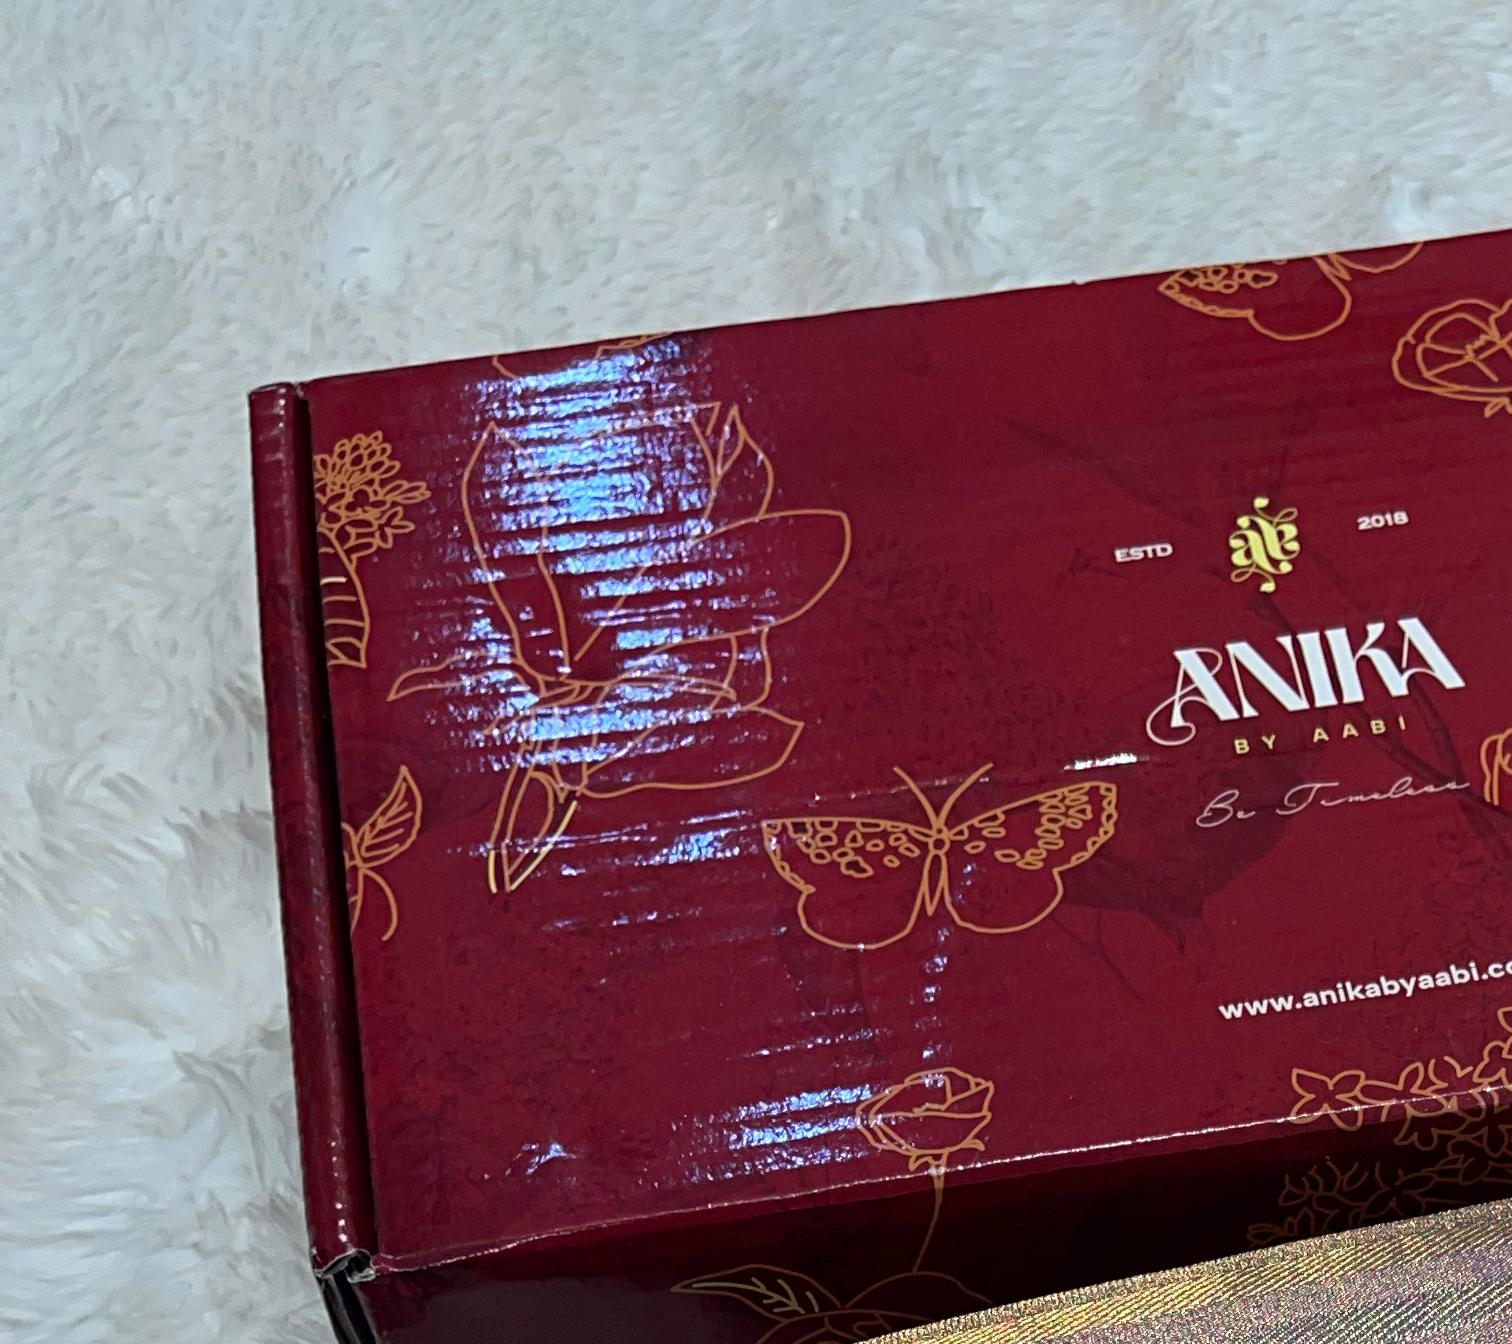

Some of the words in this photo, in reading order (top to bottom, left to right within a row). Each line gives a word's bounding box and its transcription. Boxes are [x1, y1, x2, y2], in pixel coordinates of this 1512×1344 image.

[1356, 510, 1410, 531] 2018
[1113, 542, 1174, 564] ESTD
[1147, 616, 1465, 746] ANIKA
[1233, 733, 1277, 755] BY
[1312, 715, 1407, 744] AABI
[1195, 788, 1257, 828] Be
